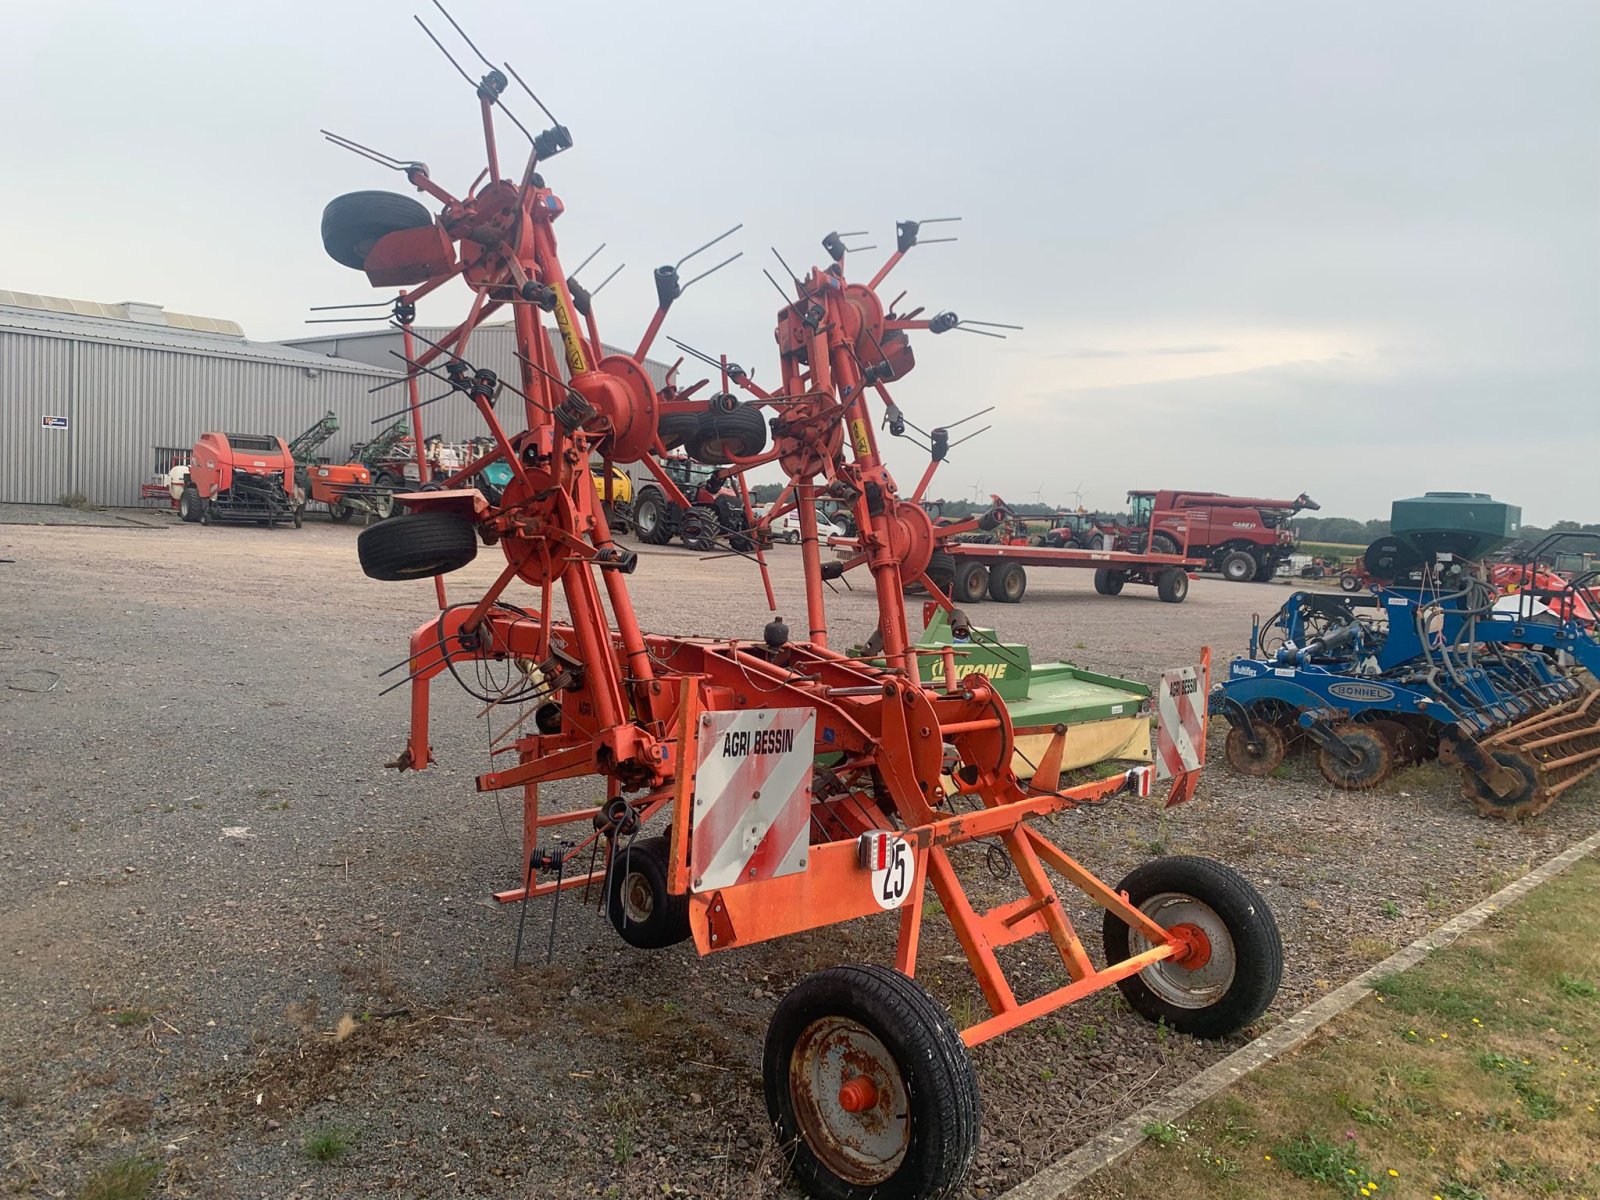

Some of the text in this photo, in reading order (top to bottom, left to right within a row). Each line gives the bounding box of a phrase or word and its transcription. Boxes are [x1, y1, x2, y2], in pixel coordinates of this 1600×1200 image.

[954, 663, 1008, 680] KRONE
[1338, 686, 1384, 698] BONNEL
[722, 728, 794, 758] AGRI BESSIN
[883, 843, 906, 900] 25
